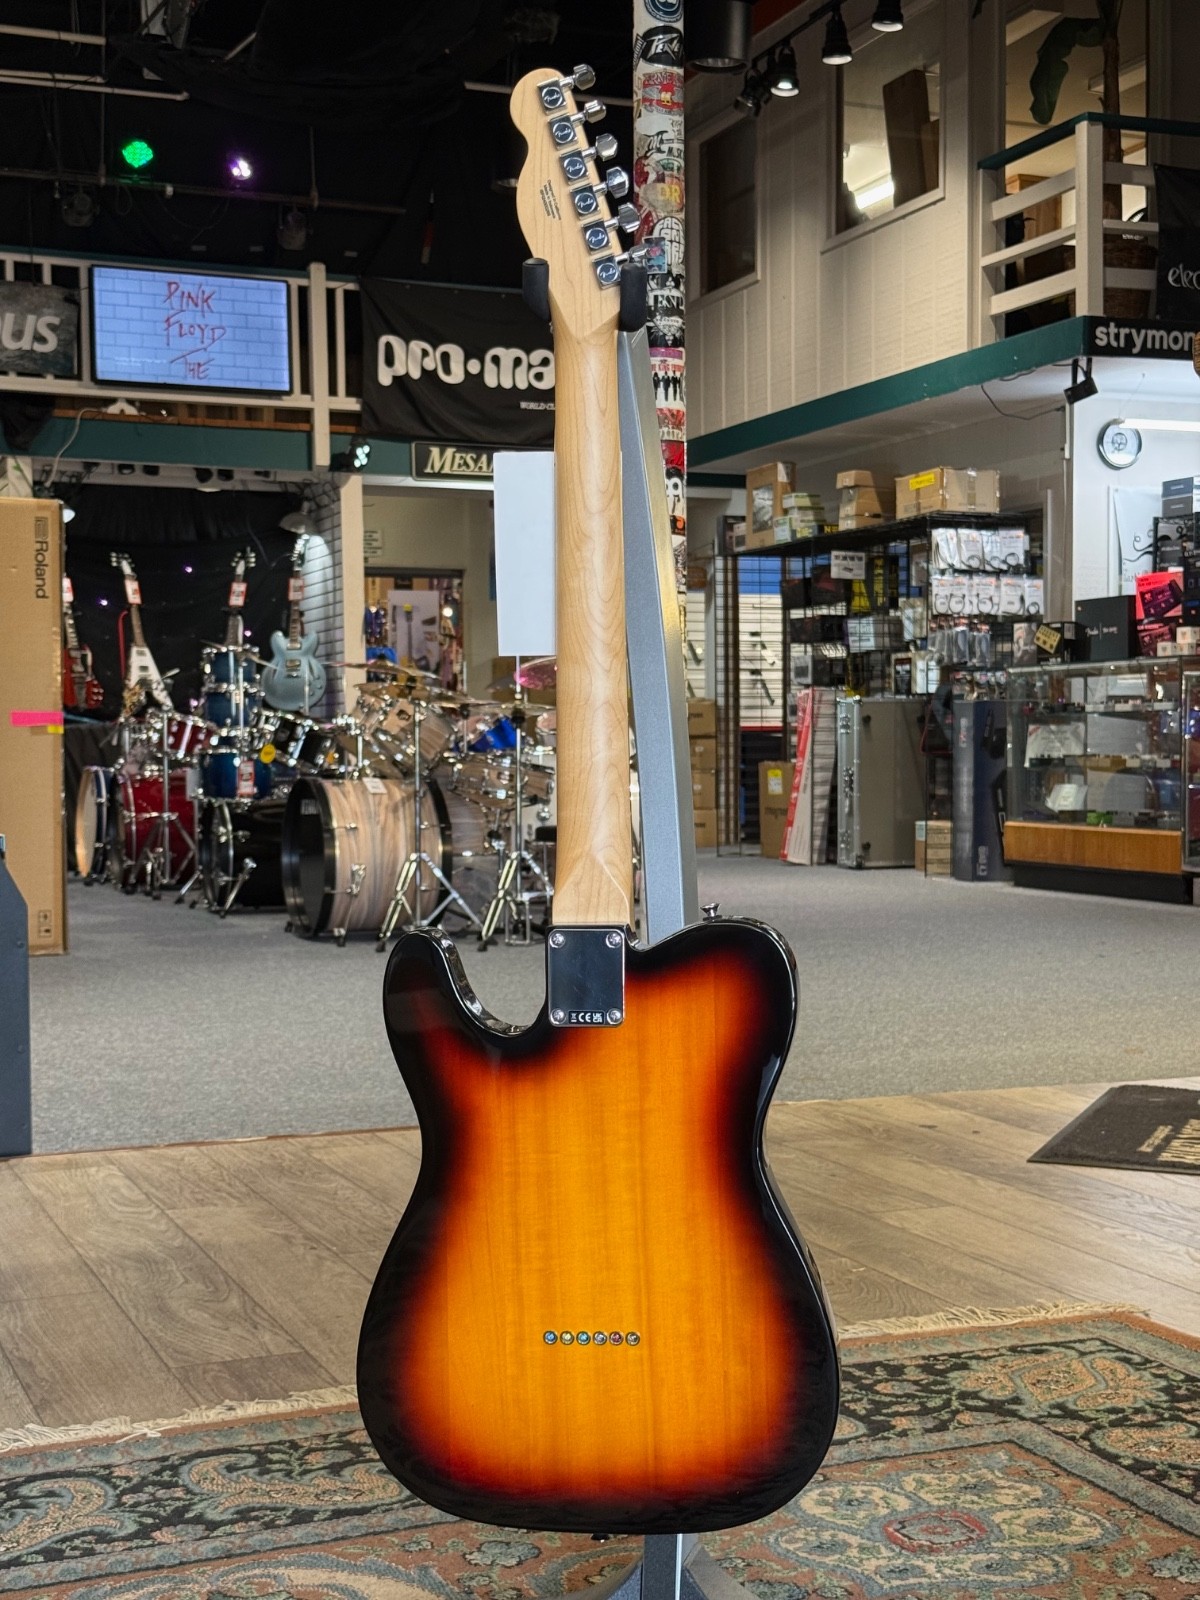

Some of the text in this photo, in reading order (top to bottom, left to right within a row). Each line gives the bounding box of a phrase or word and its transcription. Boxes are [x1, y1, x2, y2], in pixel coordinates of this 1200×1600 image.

[164, 281, 215, 317] PINK
[0, 313, 61, 353] us
[163, 310, 227, 346] FLOYD
[170, 347, 215, 380] THE
[34, 541, 49, 599] Roland
[578, 1012, 591, 1022] CE
